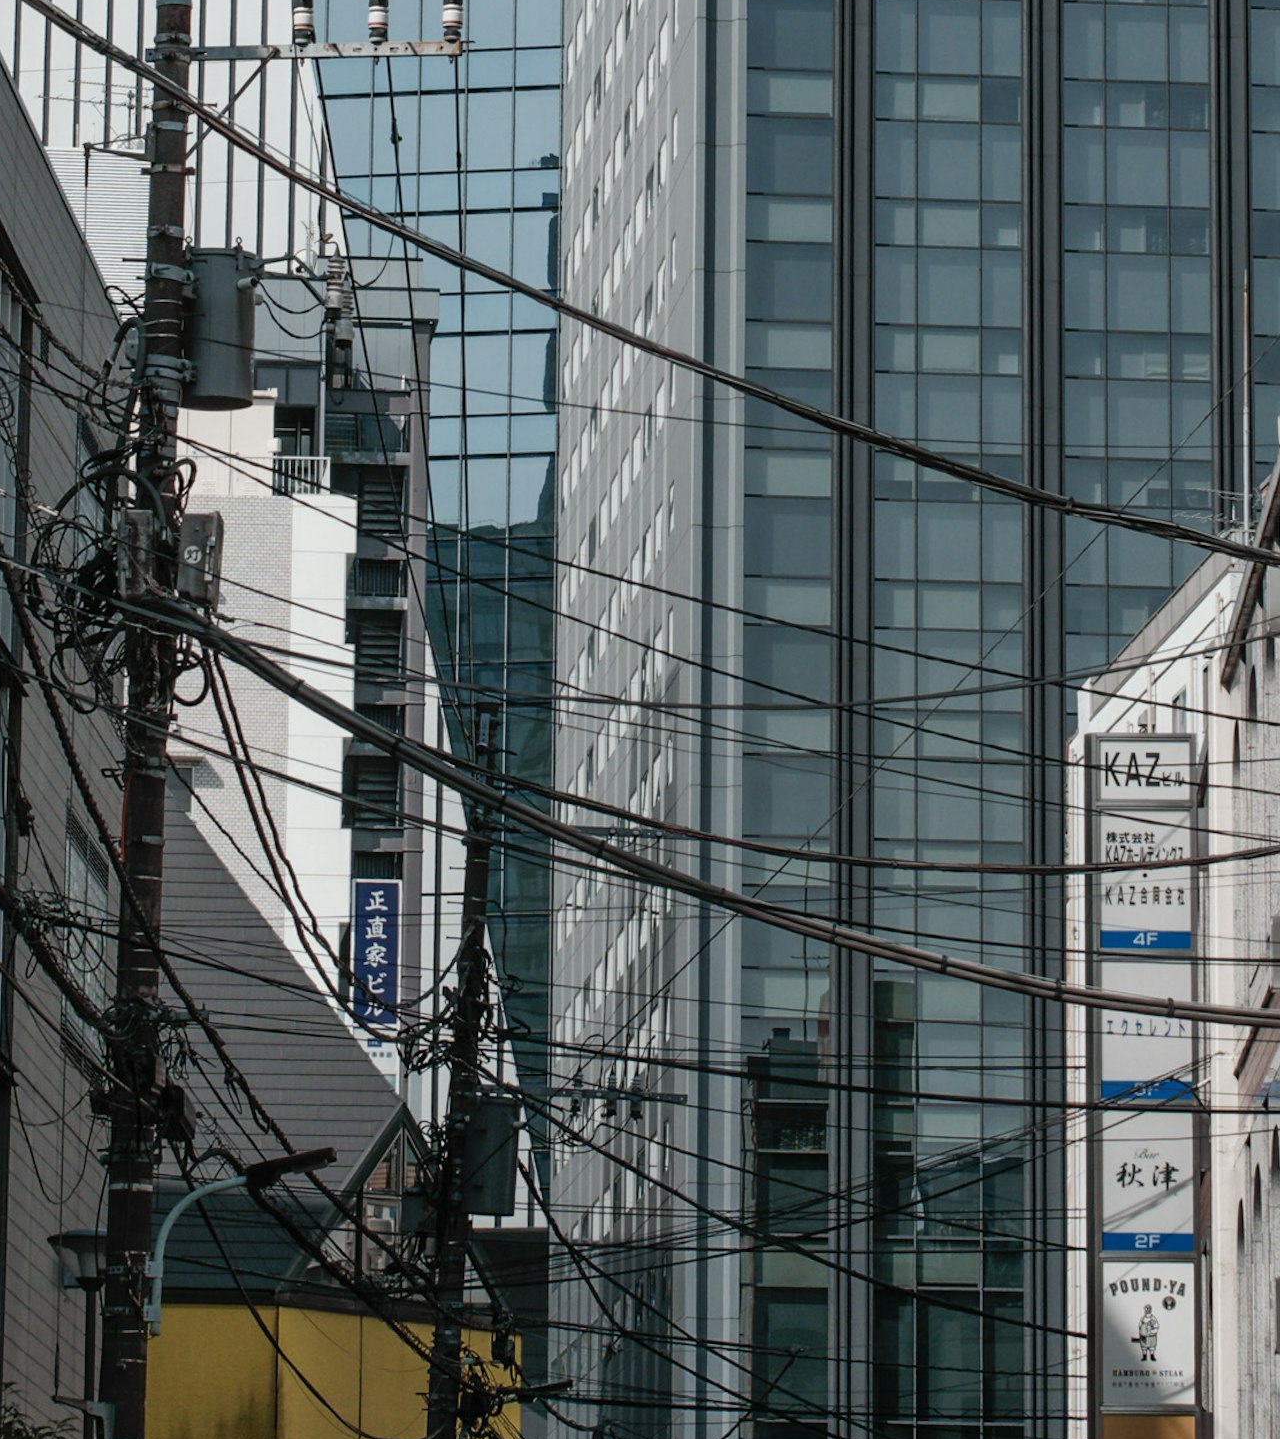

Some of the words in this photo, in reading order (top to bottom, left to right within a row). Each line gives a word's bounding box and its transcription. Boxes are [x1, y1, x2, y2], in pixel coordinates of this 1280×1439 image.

[1105, 832, 1156, 844] 株式会社
[1105, 885, 1185, 906] KAZ合同会社
[1133, 932, 1159, 946] 4F
[364, 890, 389, 1017] 正直家ビル
[1115, 1162, 1181, 1192] 秋津
[1134, 1235, 1161, 1249] 2F
